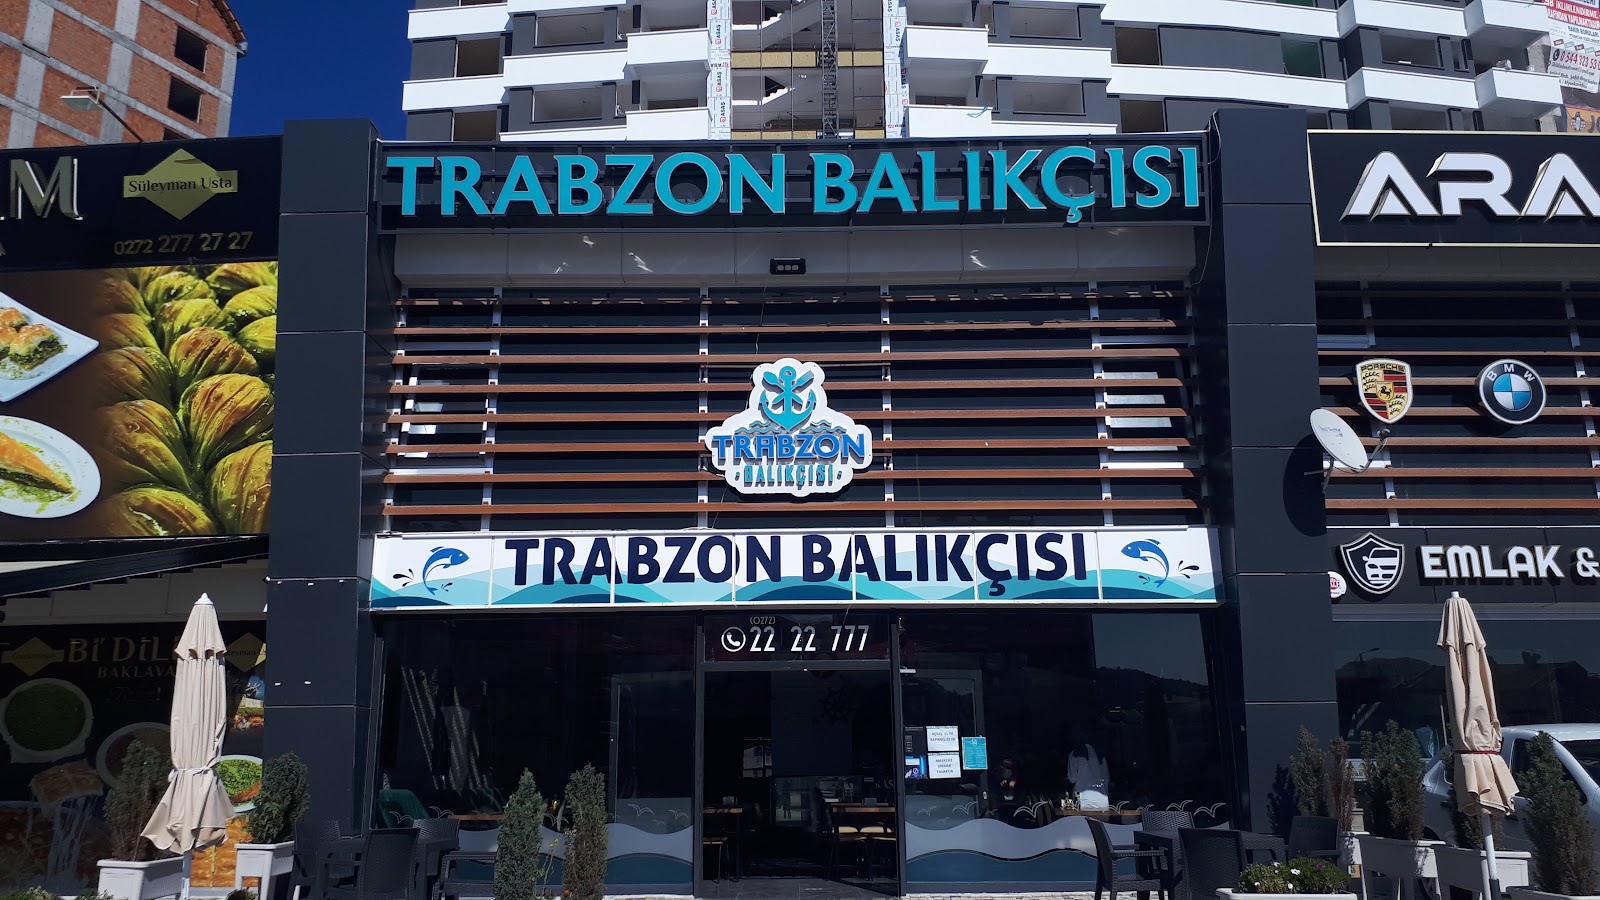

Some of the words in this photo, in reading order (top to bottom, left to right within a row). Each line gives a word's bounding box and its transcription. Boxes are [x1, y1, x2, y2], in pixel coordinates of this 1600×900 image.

[0, 155, 83, 221] M
[128, 179, 197, 194] Süleyman
[201, 177, 233, 190] Usta
[386, 152, 786, 216] TRABZON
[809, 145, 1200, 223] BALIKÇISI
[1340, 150, 1600, 218] ARA
[113, 240, 154, 255] 0272
[158, 234, 194, 254] 277
[200, 232, 224, 251] 27
[228, 231, 254, 250] 27
[1360, 362, 1406, 372] PORSCHE
[711, 433, 866, 462] TRABZON
[743, 464, 834, 488] BALIKÇISI
[504, 535, 782, 586] TRABZON
[801, 532, 1088, 597] BALIKÇISI
[1420, 545, 1566, 578] EMLAK
[1575, 547, 1600, 578] &
[749, 616, 776, 625] (0272)
[749, 625, 776, 652] 22
[790, 625, 817, 652] 22
[830, 625, 870, 652] 777
